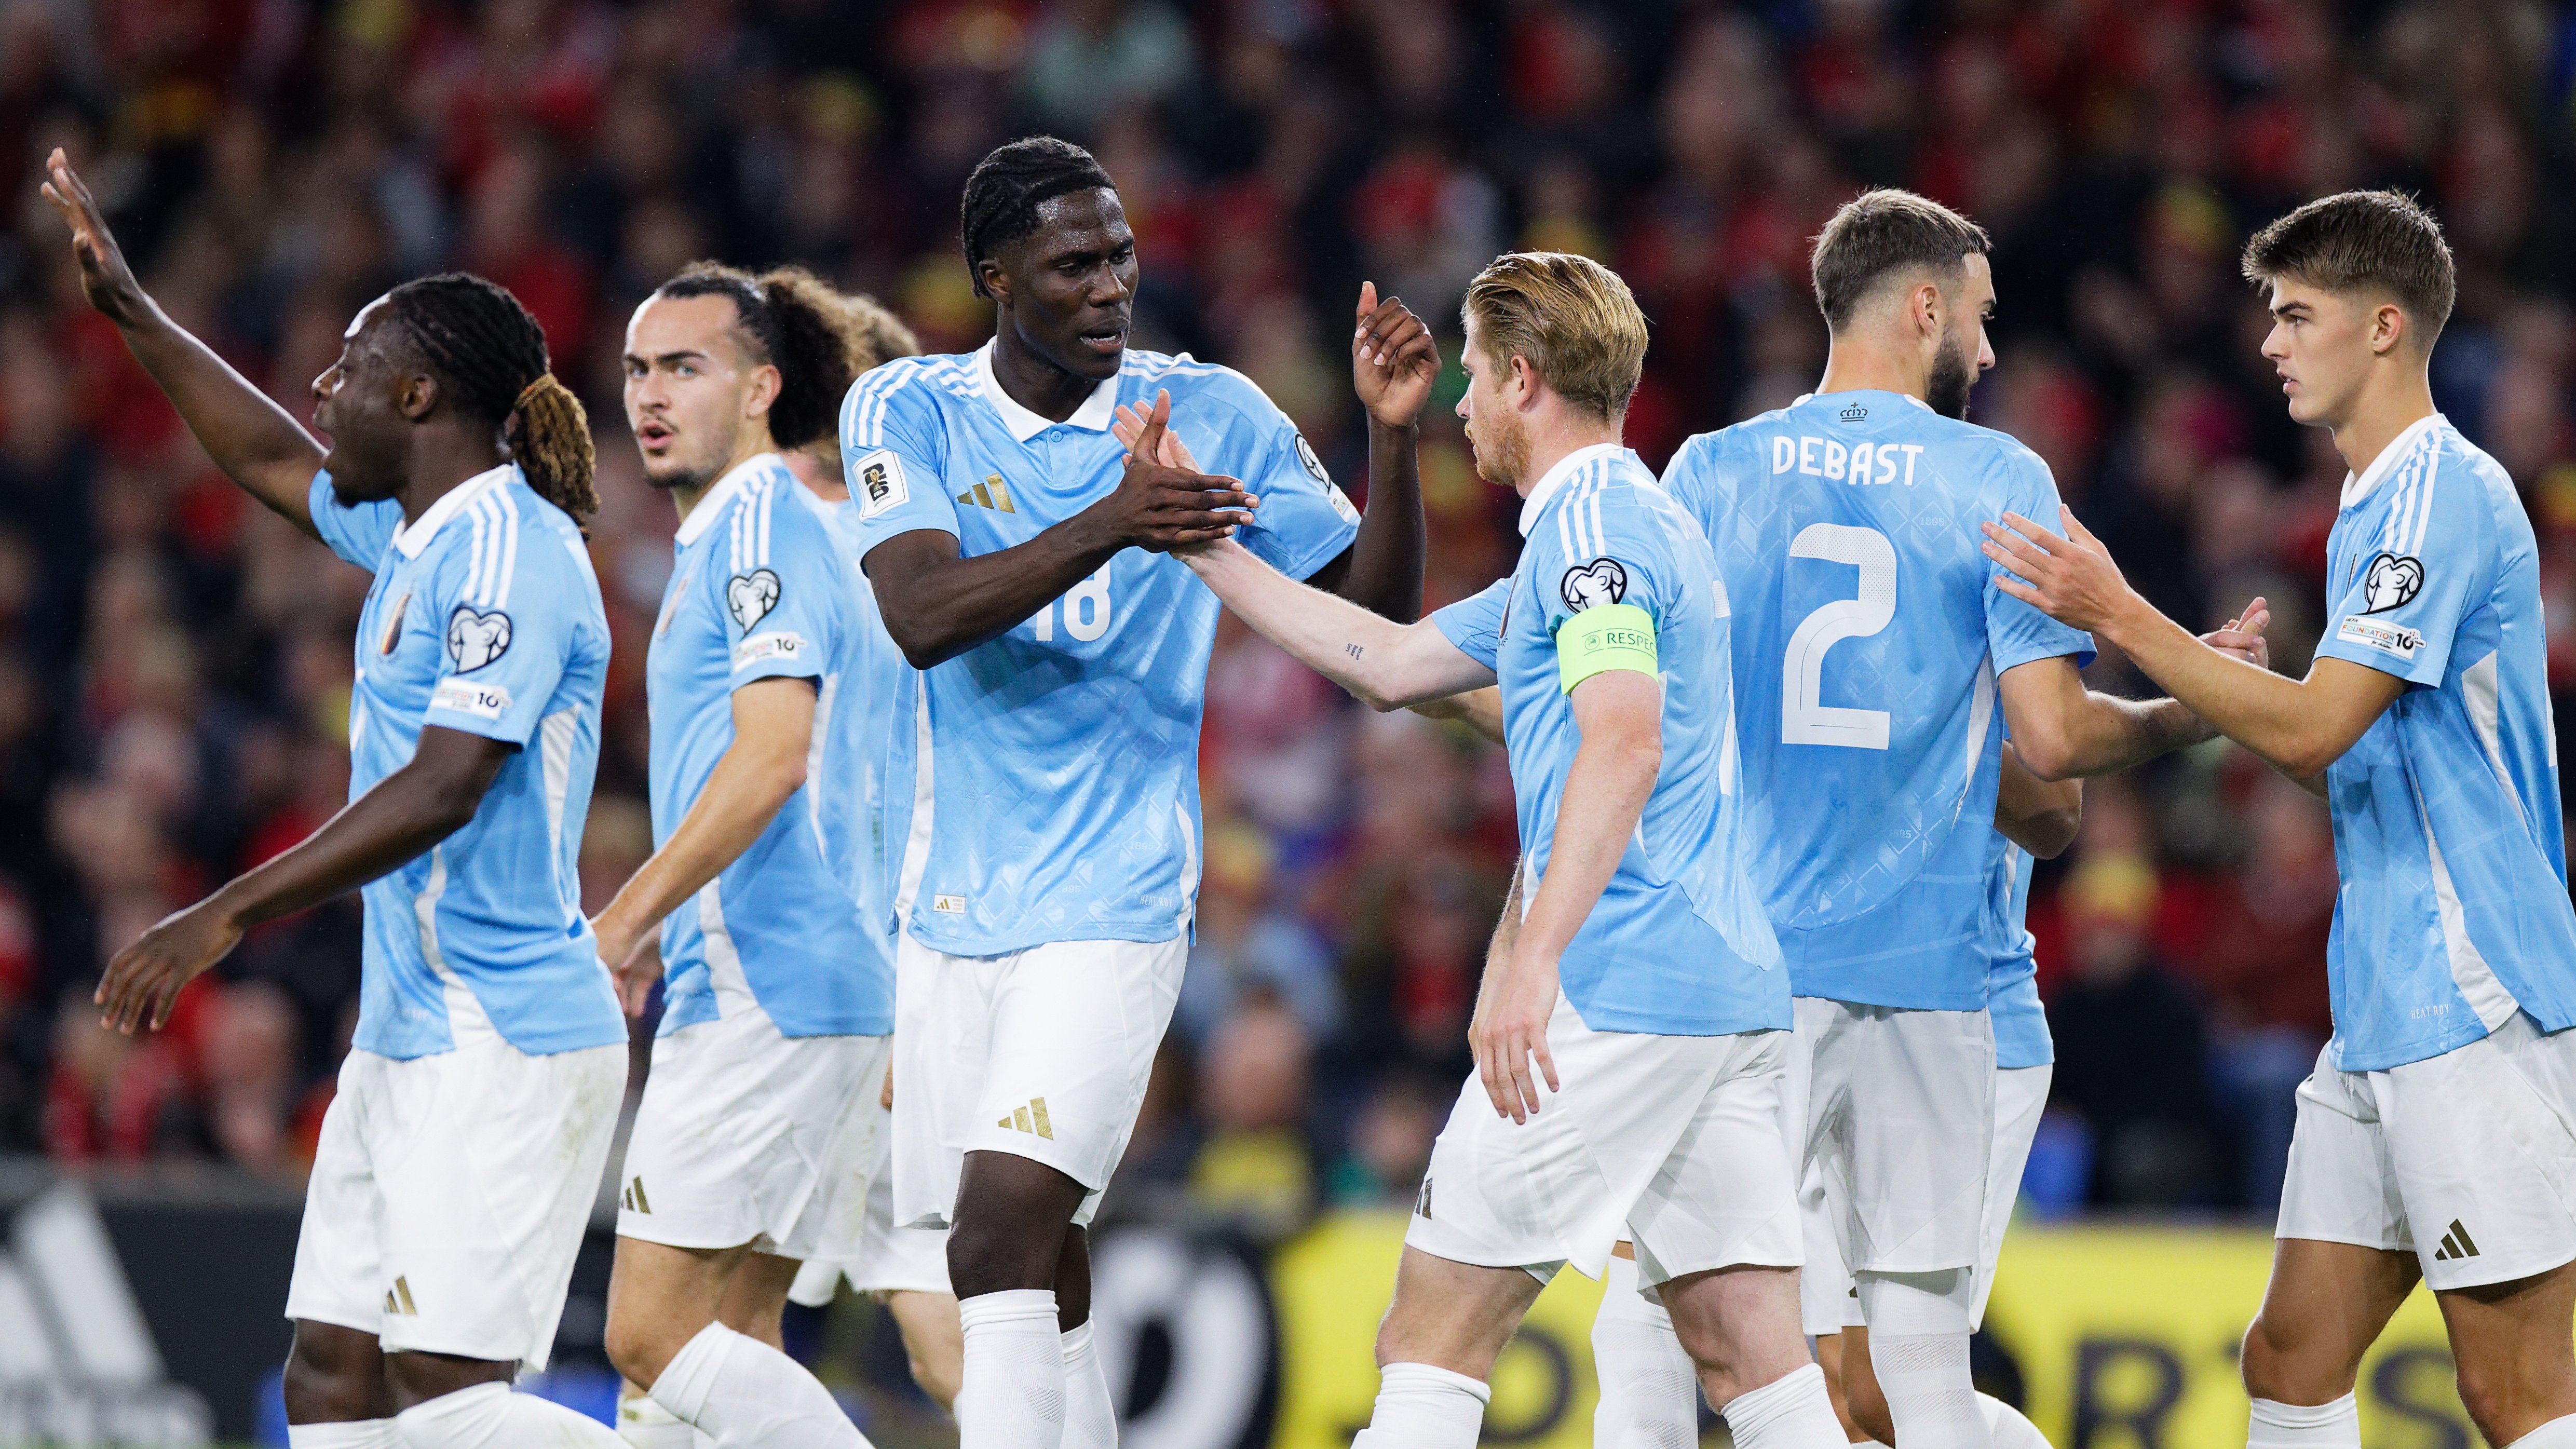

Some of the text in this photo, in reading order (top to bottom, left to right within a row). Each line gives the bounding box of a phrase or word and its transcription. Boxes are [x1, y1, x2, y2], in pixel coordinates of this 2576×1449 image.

[1772, 436, 1924, 485] DEBAST
[1782, 523, 1896, 750] 2
[2342, 625, 2394, 642] FOUNDATION
[2396, 633, 2414, 650] 10
[1607, 633, 1656, 654] RESPEC
[479, 693, 498, 707] 10
